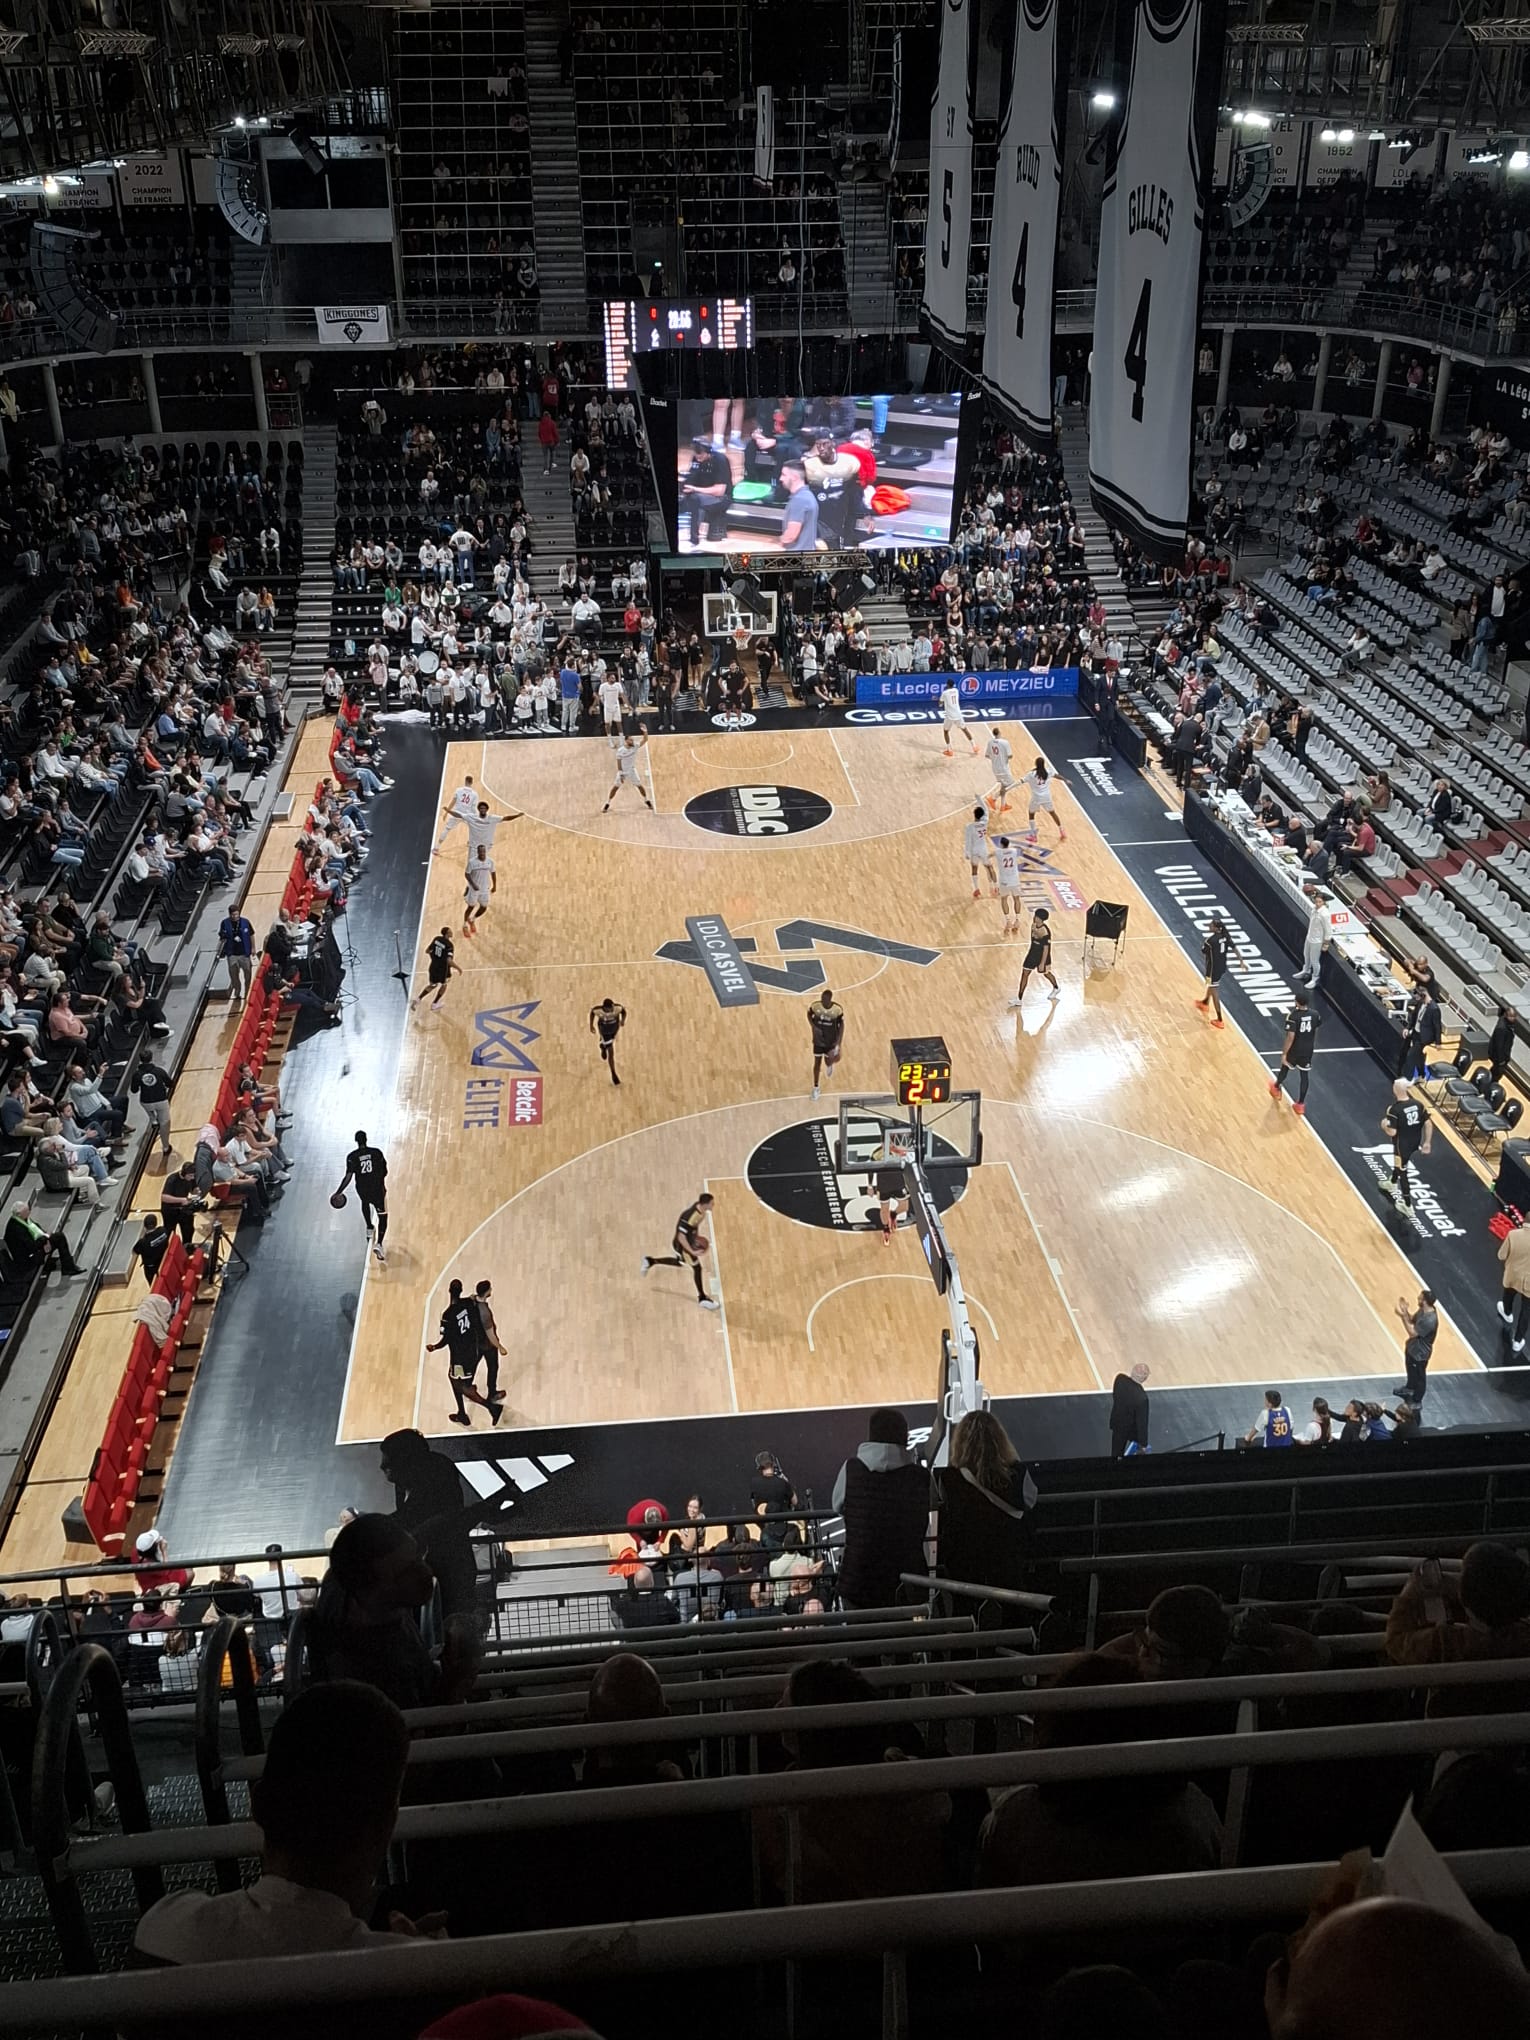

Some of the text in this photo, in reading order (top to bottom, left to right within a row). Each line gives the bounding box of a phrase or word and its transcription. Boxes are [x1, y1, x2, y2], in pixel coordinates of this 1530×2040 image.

[946, 105, 956, 138] SY
[1327, 146, 1353, 156] 1952
[134, 165, 164, 176] 2022
[1016, 144, 1040, 190] RUDD
[1392, 169, 1411, 178] LDL
[131, 187, 173, 195] CHAMPION
[941, 168, 954, 269] 5
[1128, 184, 1175, 245] GILLES
[1011, 221, 1030, 340] 4
[1124, 278, 1152, 423] 4
[1496, 379, 1507, 393] LA
[985, 677, 1055, 692] MEYZIEU
[461, 792, 471, 805] 26
[738, 787, 789, 834] LDLC
[1003, 857, 1014, 868] 22
[696, 920, 747, 993] LDLC ASVEL
[464, 1078, 505, 1130] ÉLITE
[515, 1080, 538, 1122] Betclic
[360, 1159, 373, 1174] 23
[810, 1124, 845, 1225] HIGH-TECH EXPERIENCE
[1362, 1154, 1389, 1182] Intérim
[458, 1315, 471, 1335] 24
[1272, 1422, 1288, 1437] 30
